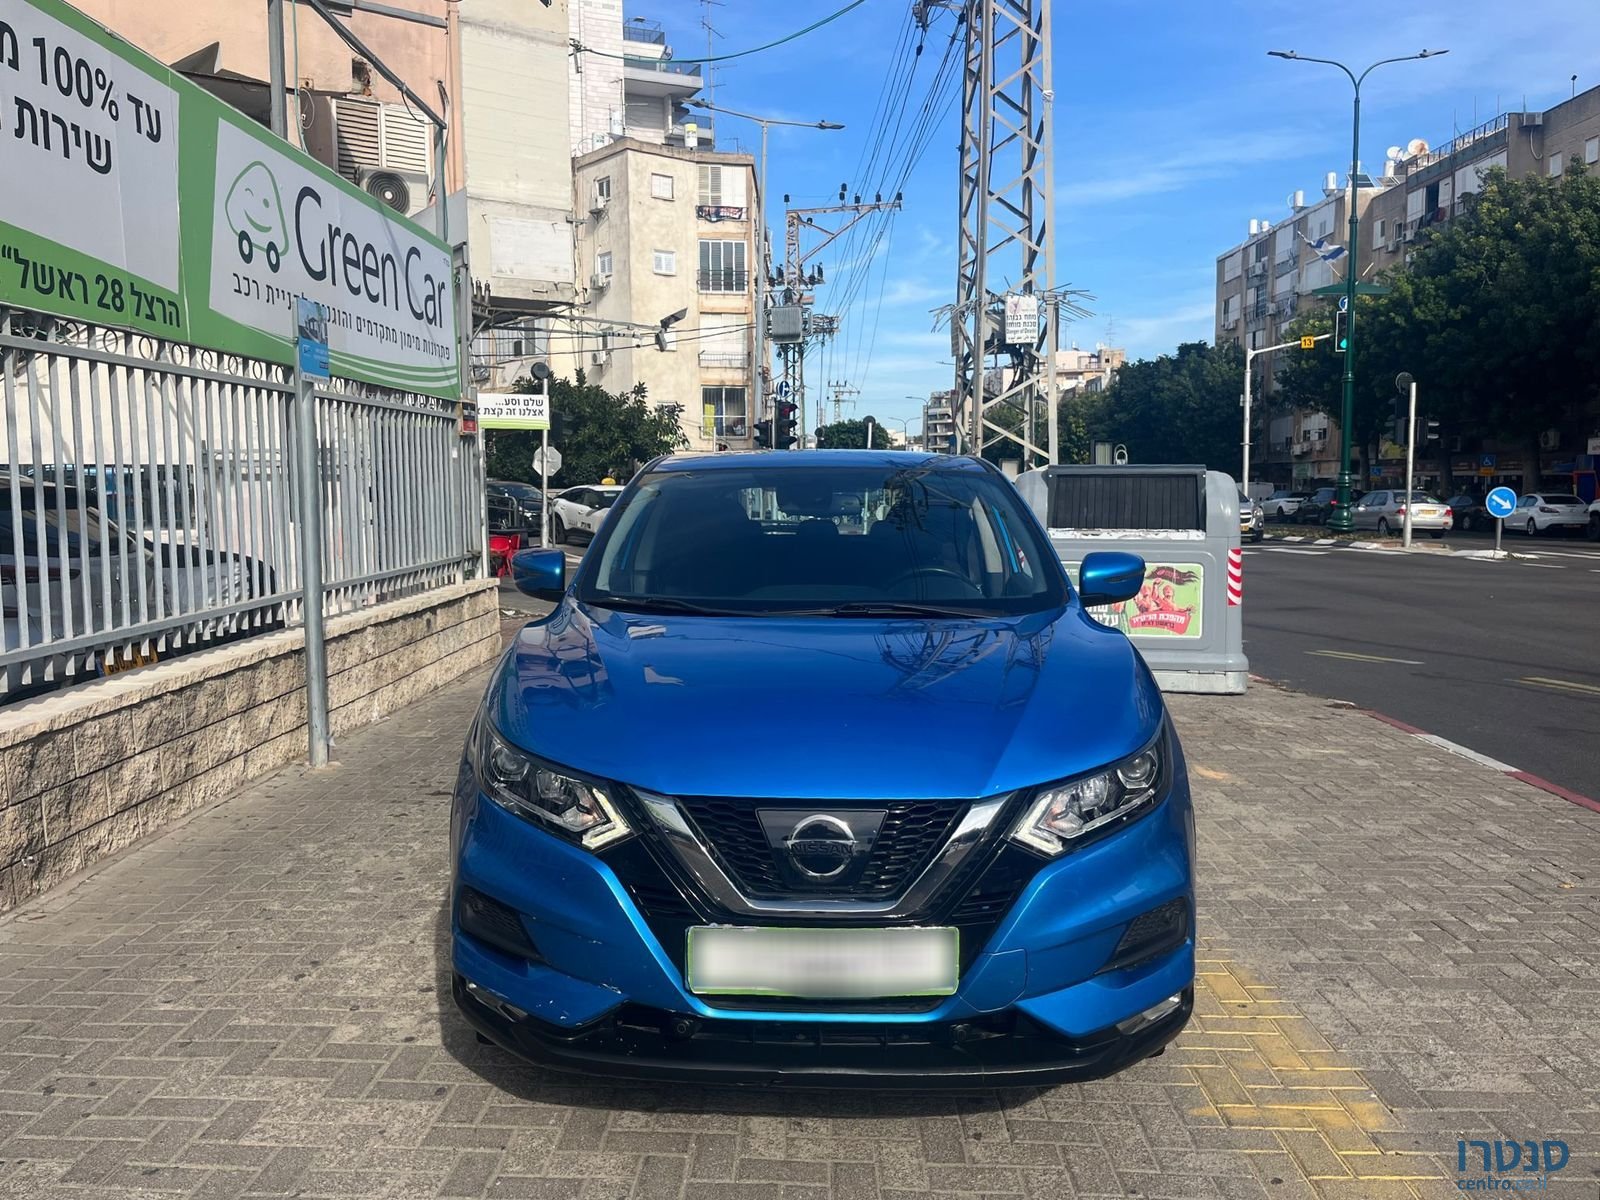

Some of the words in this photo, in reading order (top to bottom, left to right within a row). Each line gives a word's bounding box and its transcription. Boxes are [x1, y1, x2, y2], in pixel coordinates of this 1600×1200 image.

[32, 37, 120, 122] 100%
[127, 92, 161, 143] עד
[14, 95, 112, 175] שירות
[294, 186, 399, 312] Green
[405, 246, 446, 328] Car
[95, 273, 125, 313] 28
[232, 272, 260, 300] רכב
[130, 282, 181, 328] הרצל
[355, 315, 398, 344] מתקדמים
[399, 331, 421, 350] מימון
[1303, 338, 1312, 346] 13
[422, 338, 450, 361] פתרונות
[483, 407, 503, 417] קצת
[505, 407, 516, 416] זה
[519, 406, 544, 417] אצלנו
[523, 397, 544, 407] שלם
[790, 842, 853, 858] NISSAN
